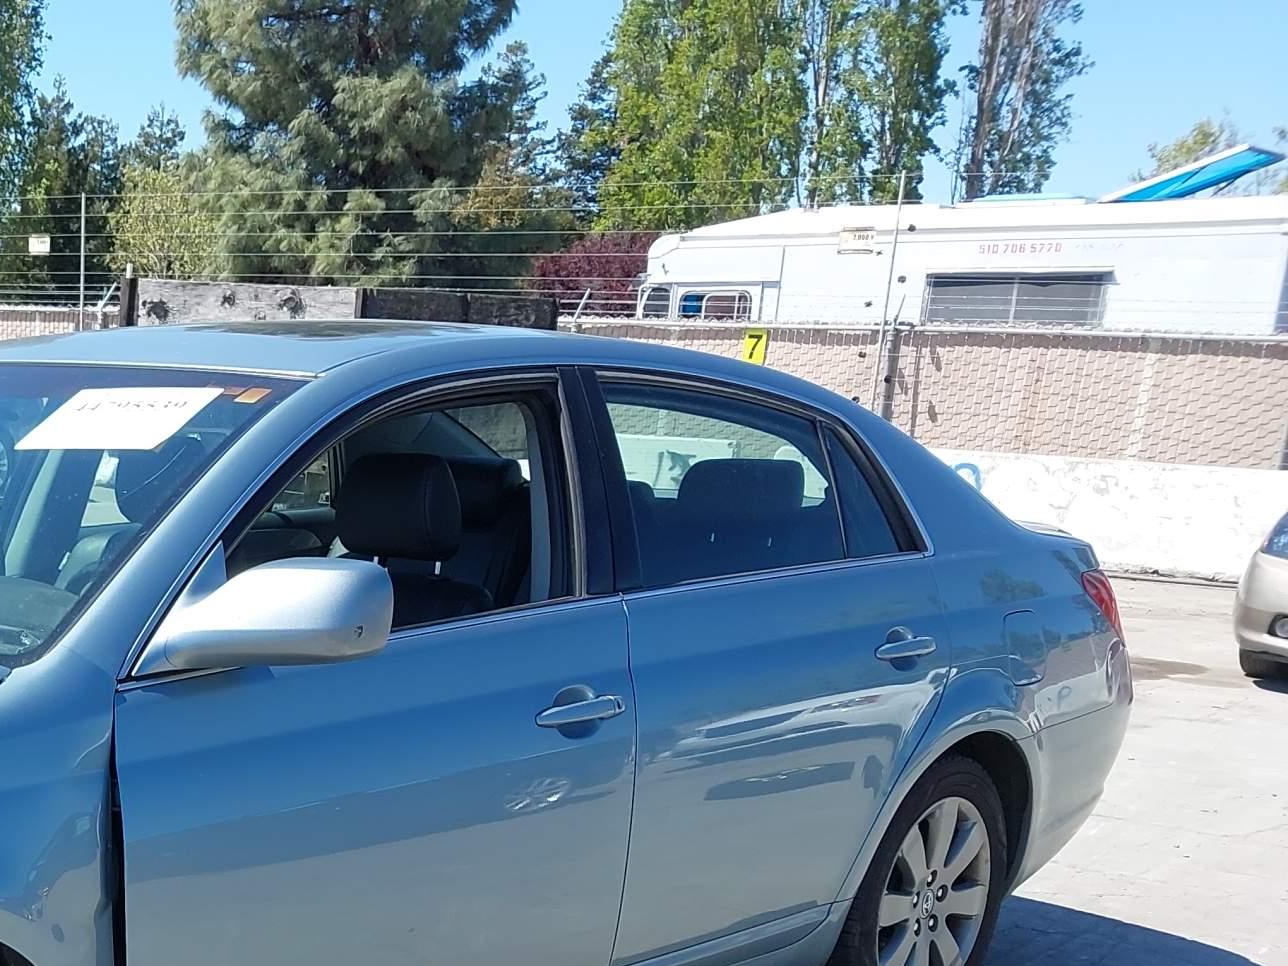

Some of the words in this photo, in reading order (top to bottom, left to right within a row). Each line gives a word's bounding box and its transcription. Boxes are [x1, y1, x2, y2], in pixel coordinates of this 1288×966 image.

[978, 244, 999, 255] 510
[1030, 242, 1063, 253] 5770
[748, 334, 763, 360] 7
